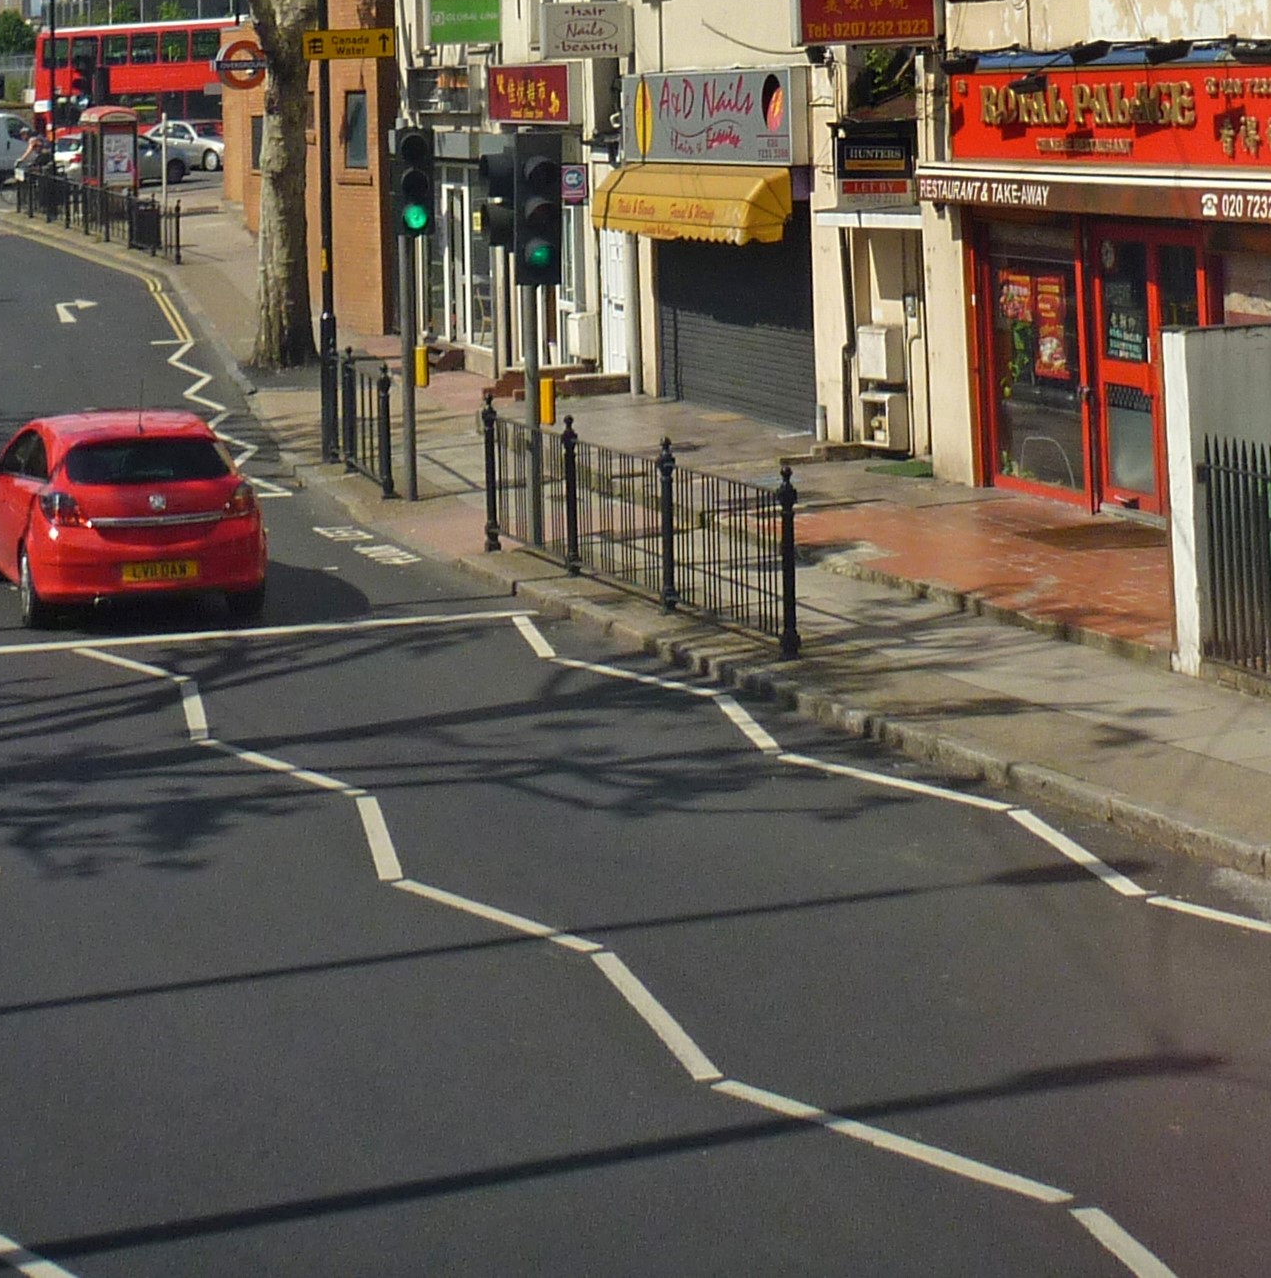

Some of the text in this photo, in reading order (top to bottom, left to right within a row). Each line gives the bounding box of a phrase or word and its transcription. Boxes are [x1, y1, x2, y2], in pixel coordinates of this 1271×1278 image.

[445, 12, 477, 21] GLOBAL
[566, 21, 605, 38] Nails
[834, 22, 866, 37] 0207
[869, 21, 895, 36] 232
[898, 19, 929, 35] 1323
[330, 35, 370, 45] Canada
[335, 46, 367, 55] Water
[701, 74, 754, 121] Nails
[979, 80, 1197, 129] ROYAL PALACE
[671, 129, 694, 155] Hair
[850, 148, 902, 159] HUNTERS
[919, 180, 1050, 206] RESTAURANT & TAKE-AWAY
[1221, 194, 1243, 217] 020
